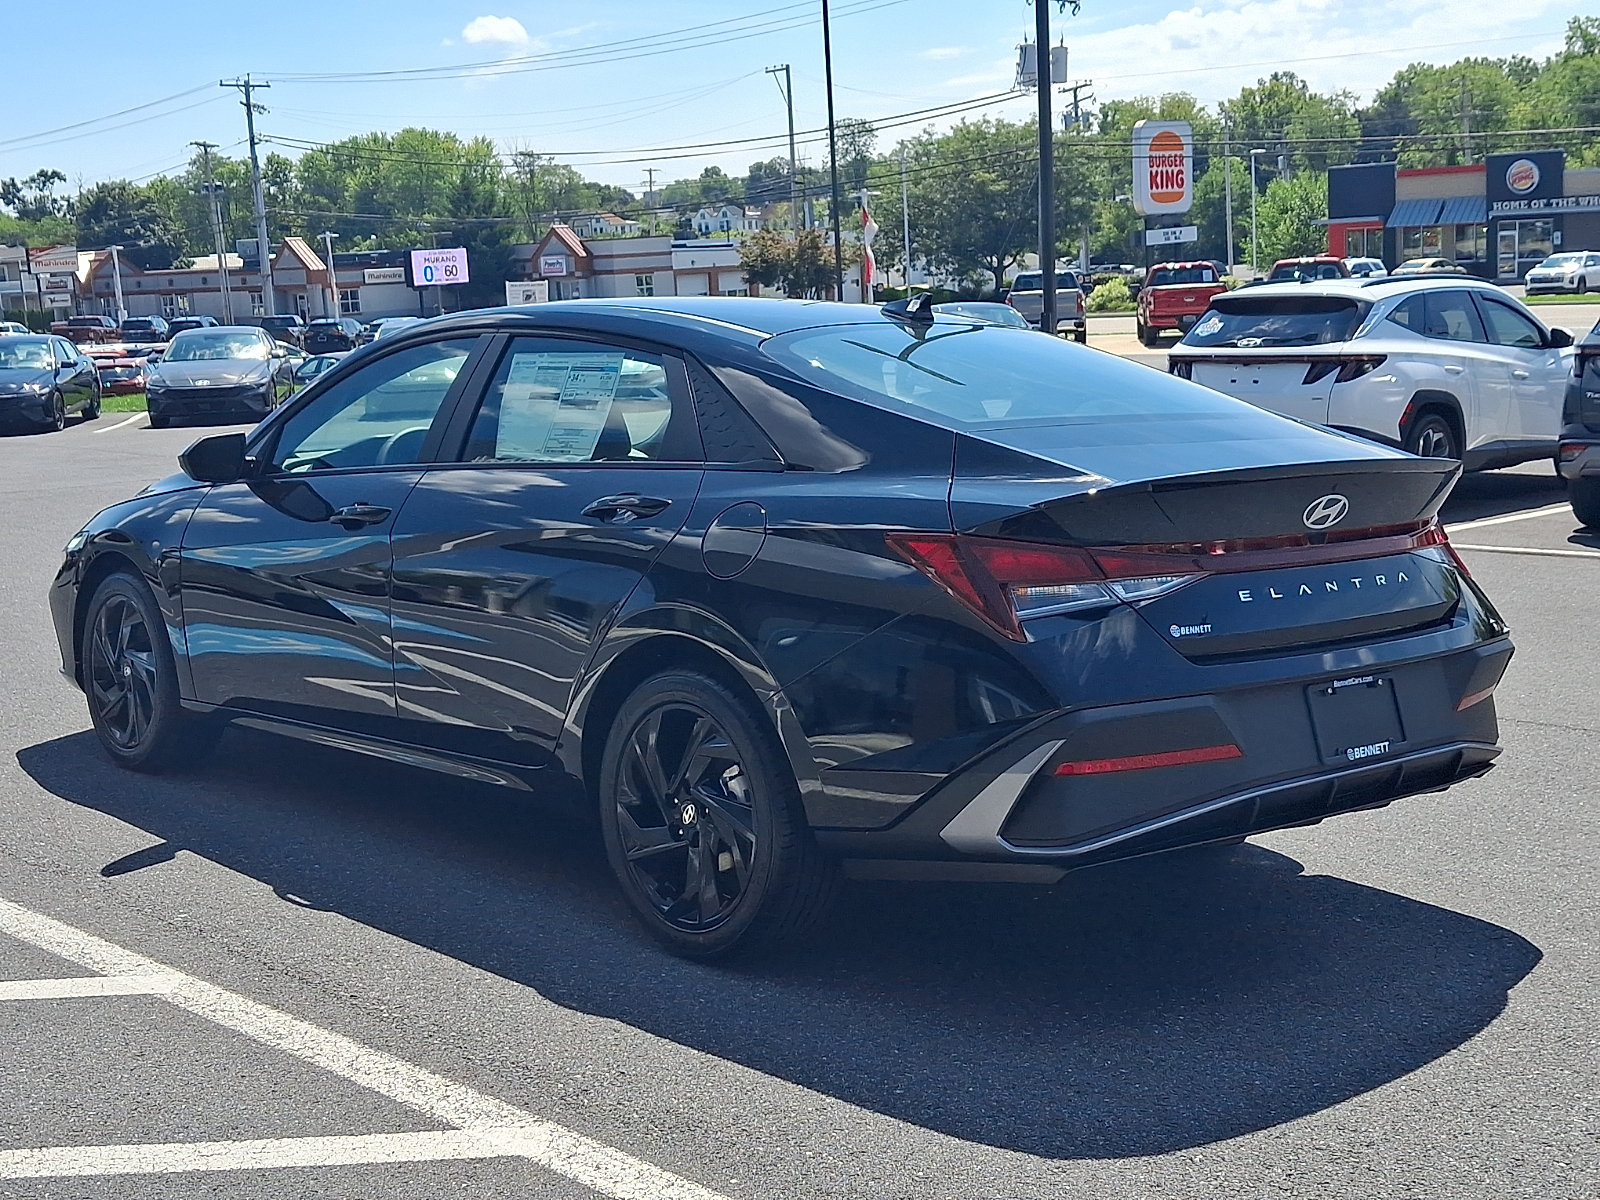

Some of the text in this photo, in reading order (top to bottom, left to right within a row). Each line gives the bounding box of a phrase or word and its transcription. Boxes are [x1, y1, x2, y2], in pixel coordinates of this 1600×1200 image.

[1148, 153, 1185, 168] BURGER
[1149, 169, 1185, 190] KING
[1493, 196, 1600, 211] HOME OF THE WH
[35, 260, 76, 268] Mahindra
[423, 255, 457, 264] MURANO
[367, 272, 402, 280] Mahindra
[444, 264, 458, 277] 60
[1239, 572, 1409, 602] ELANTRA
[1180, 624, 1212, 635] BENNETT
[1354, 741, 1390, 759] BENNETT
